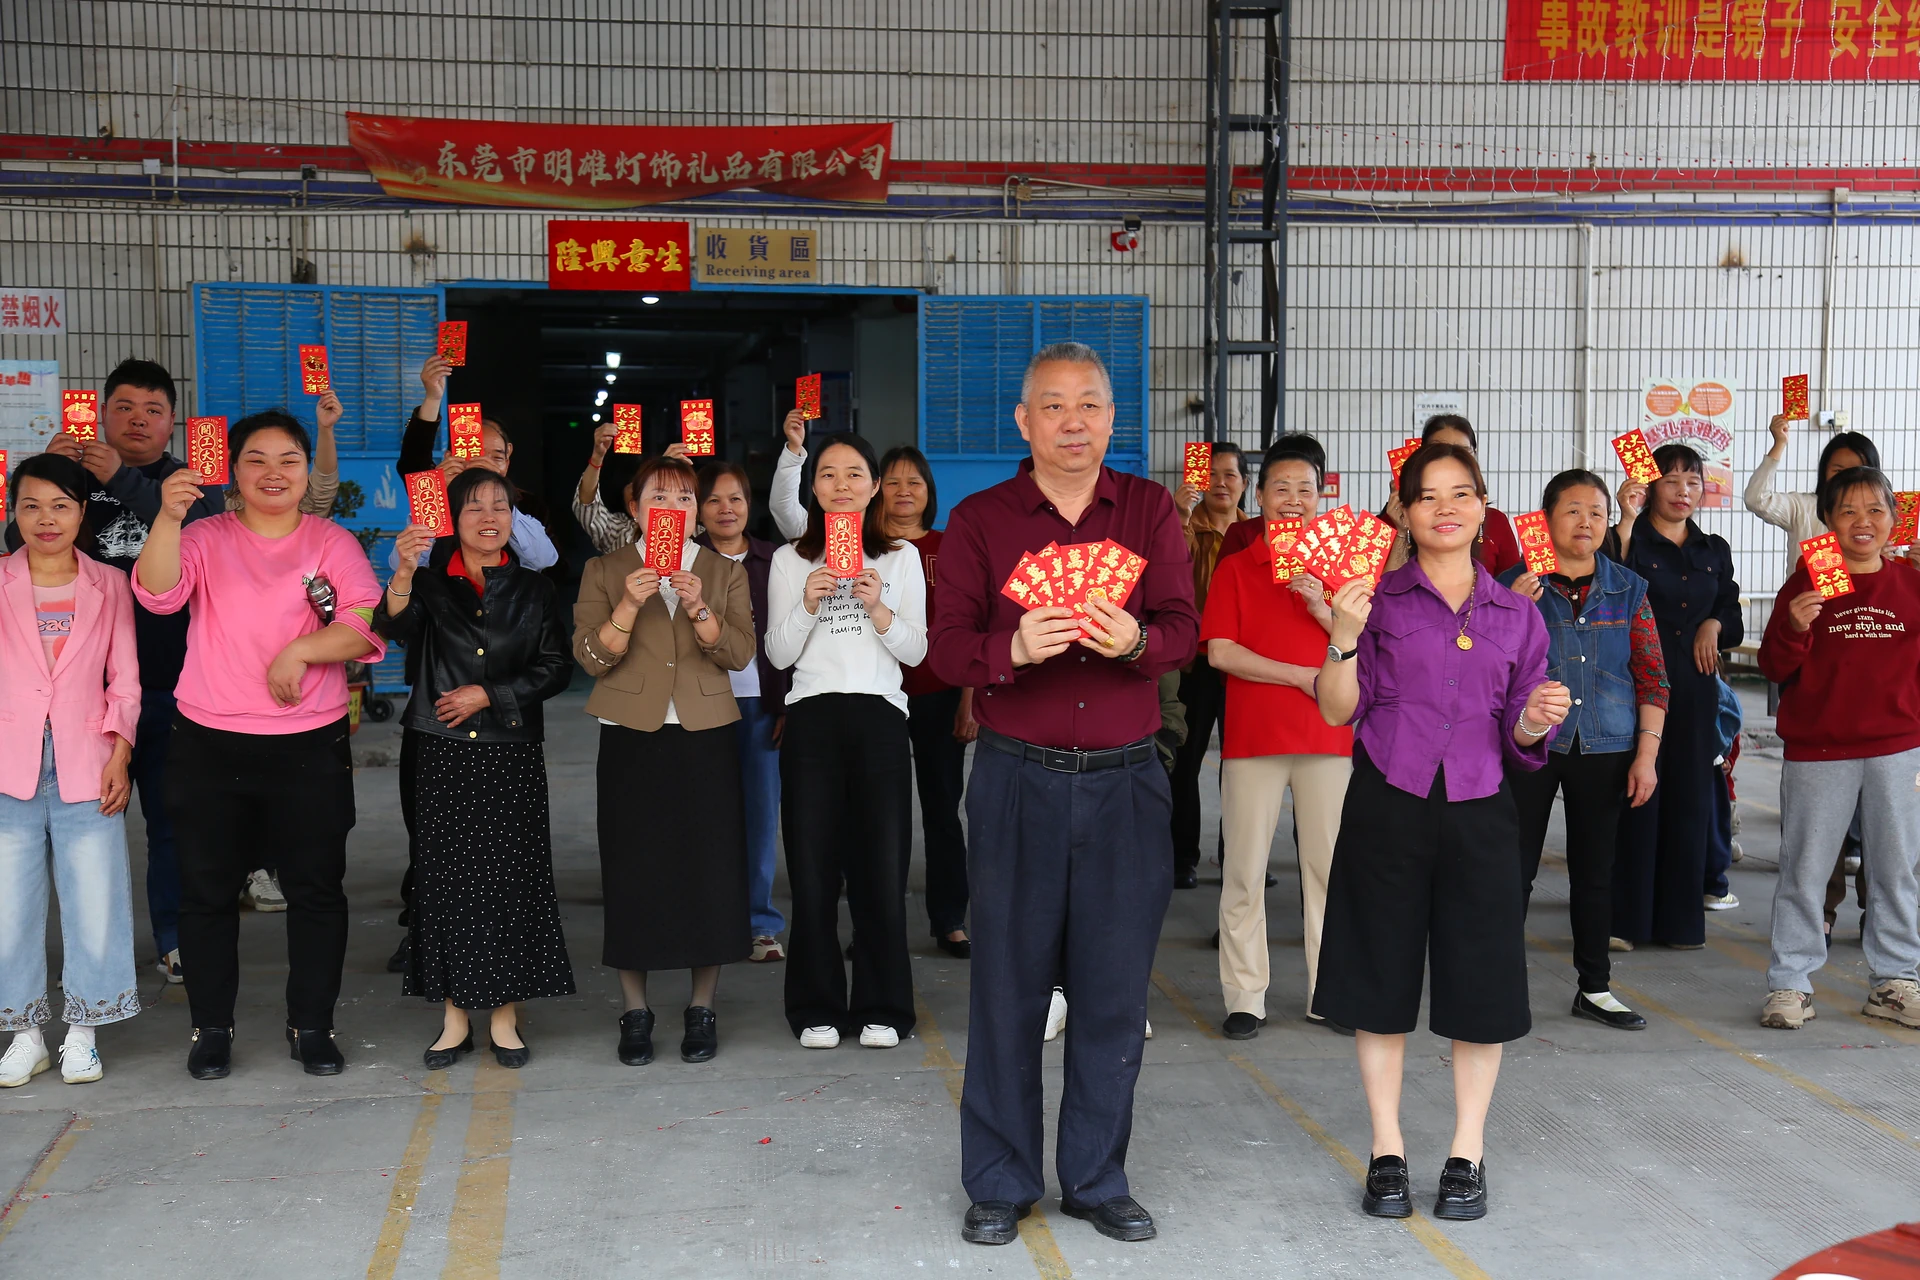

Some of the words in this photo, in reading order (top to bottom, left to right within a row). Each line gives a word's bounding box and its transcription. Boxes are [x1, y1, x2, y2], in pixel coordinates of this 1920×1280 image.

[1536, 0, 1806, 60] 事故教训是镜子
[437, 140, 885, 187] 东莞市明雄灯饰礼品有限公司
[706, 234, 811, 262] 收貨區
[706, 264, 776, 280] Receiving
[779, 269, 811, 278] area
[828, 603, 850, 611] rain
[819, 615, 833, 625] say
[838, 613, 859, 622] sorry
[1885, 609, 1896, 619] life
[830, 625, 862, 635] falling
[1828, 624, 1852, 633] new
[1855, 621, 1882, 632] style
[1885, 622, 1906, 632] and
